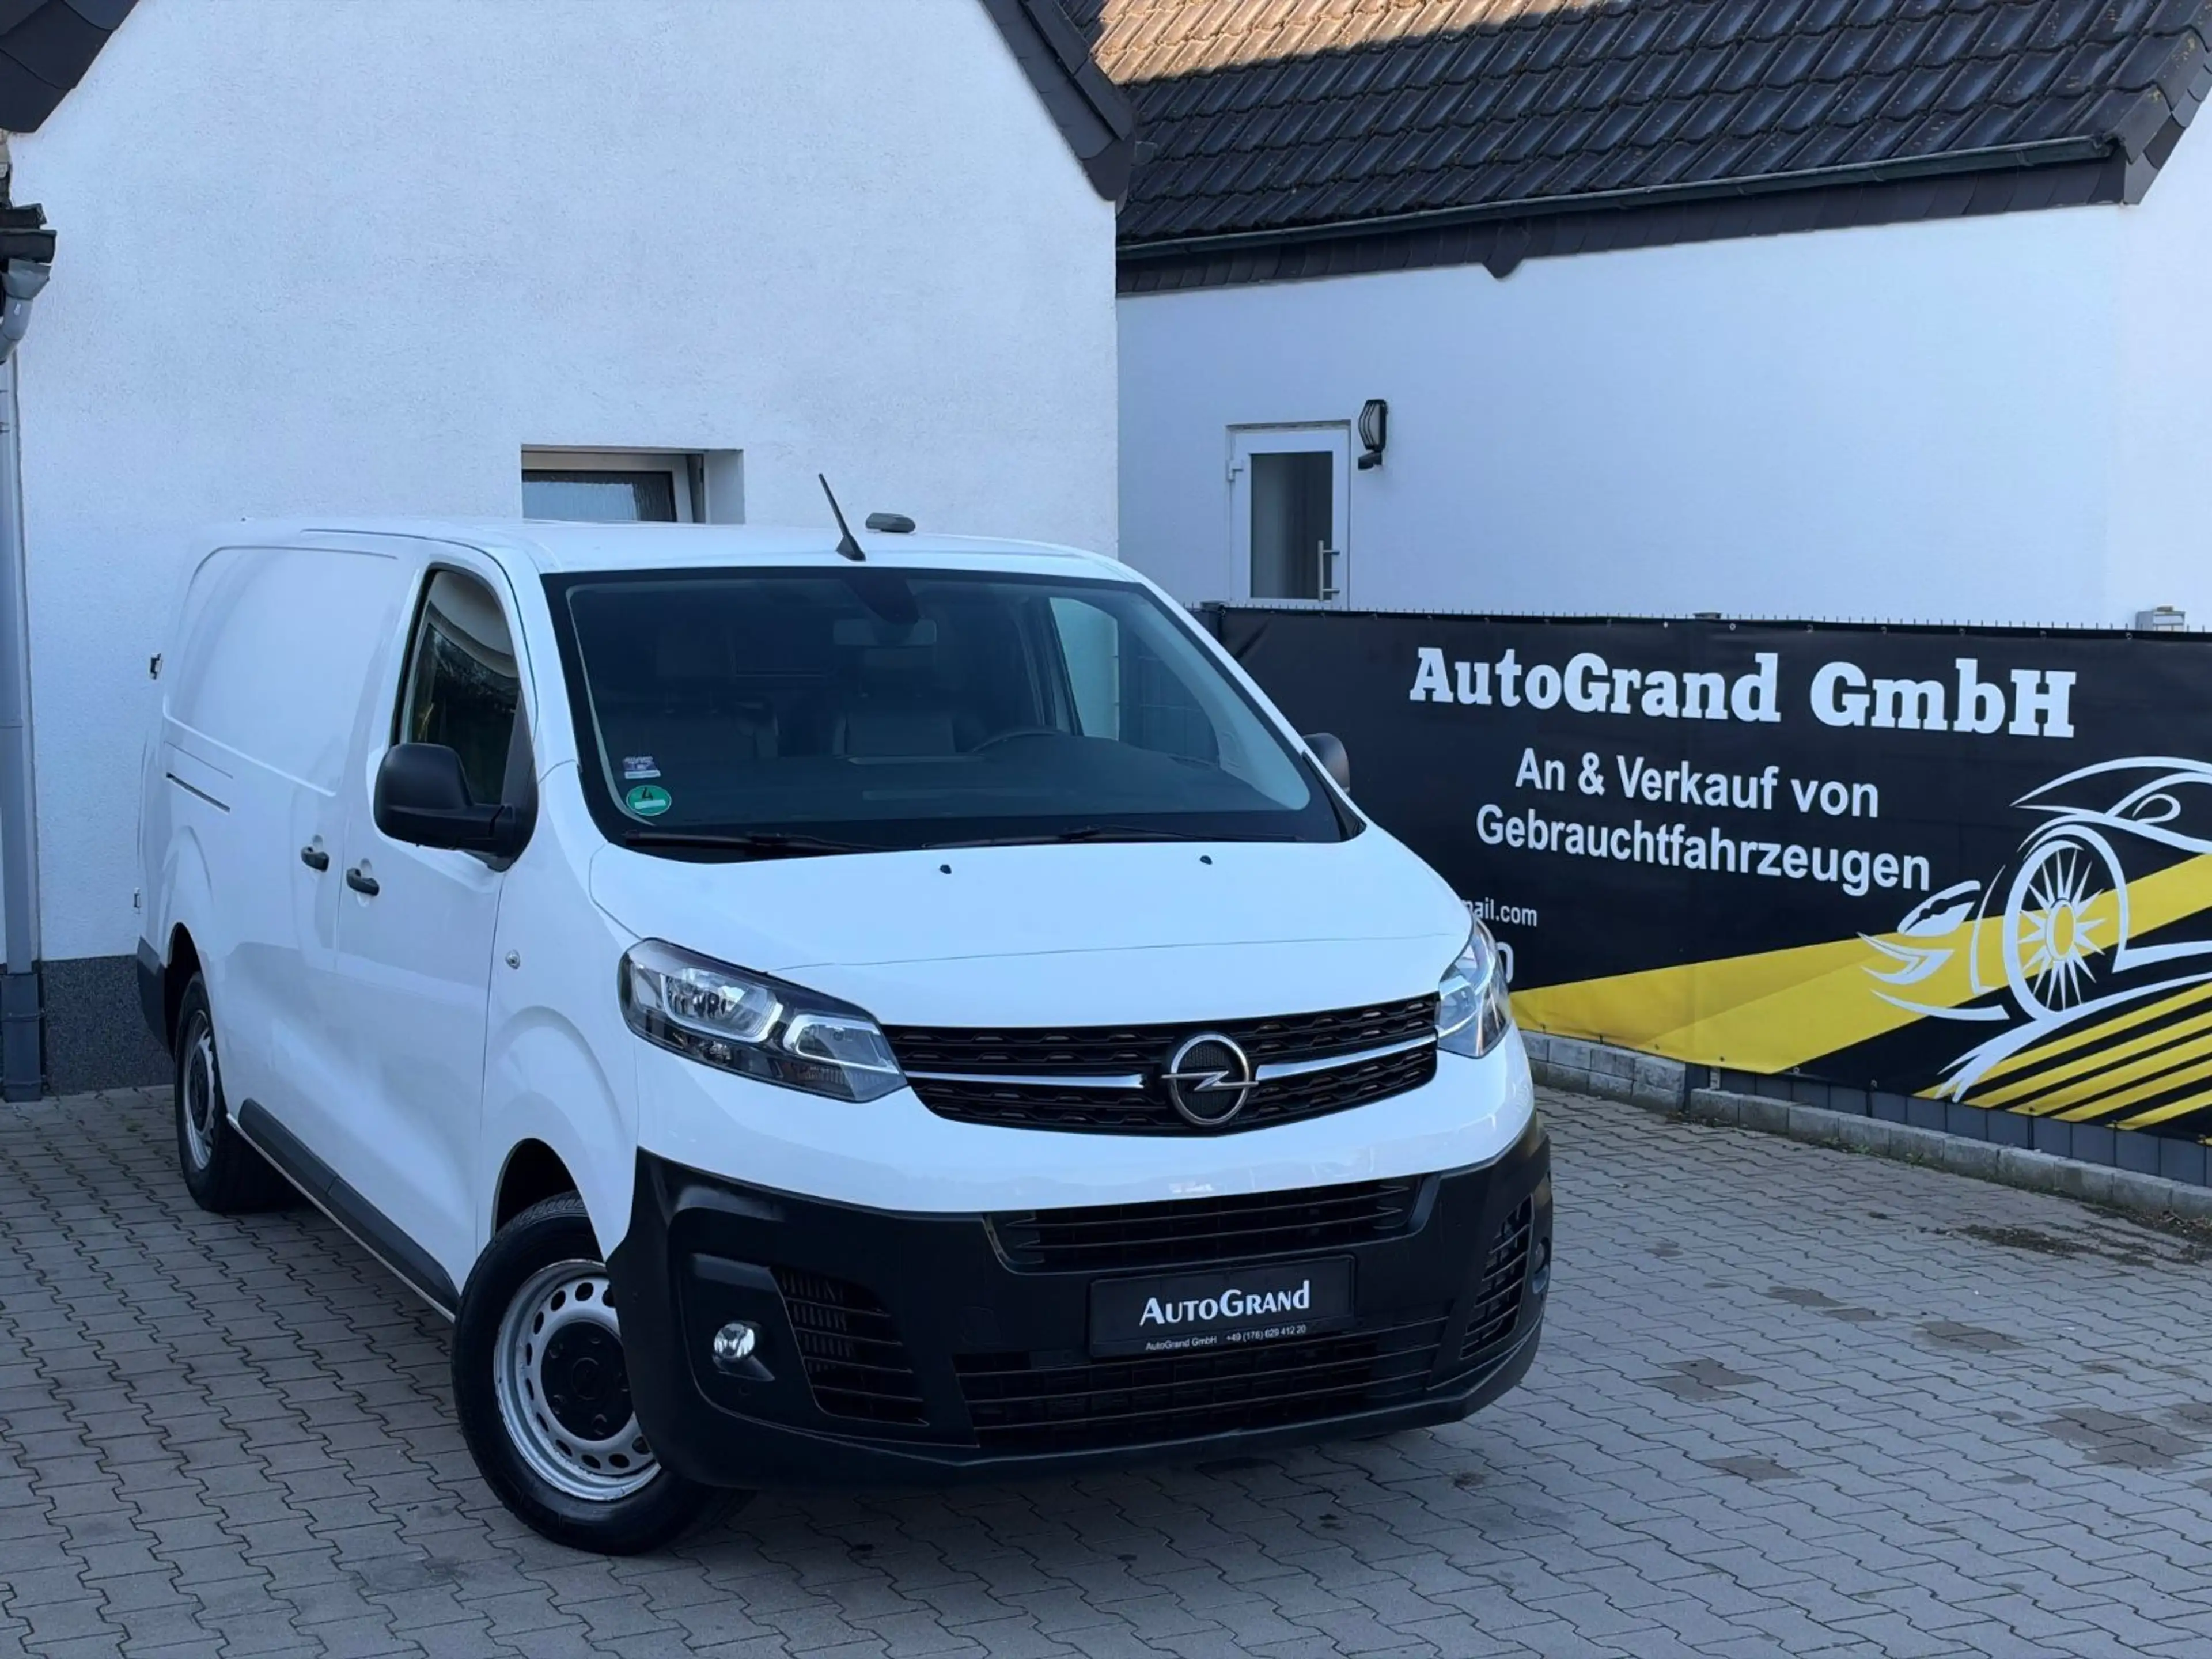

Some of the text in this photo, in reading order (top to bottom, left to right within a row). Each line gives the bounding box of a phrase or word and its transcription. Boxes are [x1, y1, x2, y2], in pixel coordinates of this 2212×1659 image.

[1410, 647, 2077, 738] AutoGrand GmbH
[641, 786, 653, 800] 4
[1515, 748, 1879, 818] An & Verkauf von
[1476, 804, 1930, 897] Gebrauchtfahrzeugen
[1145, 1338, 1190, 1350] AutoGrand
[1192, 1335, 1218, 1347] GmbH
